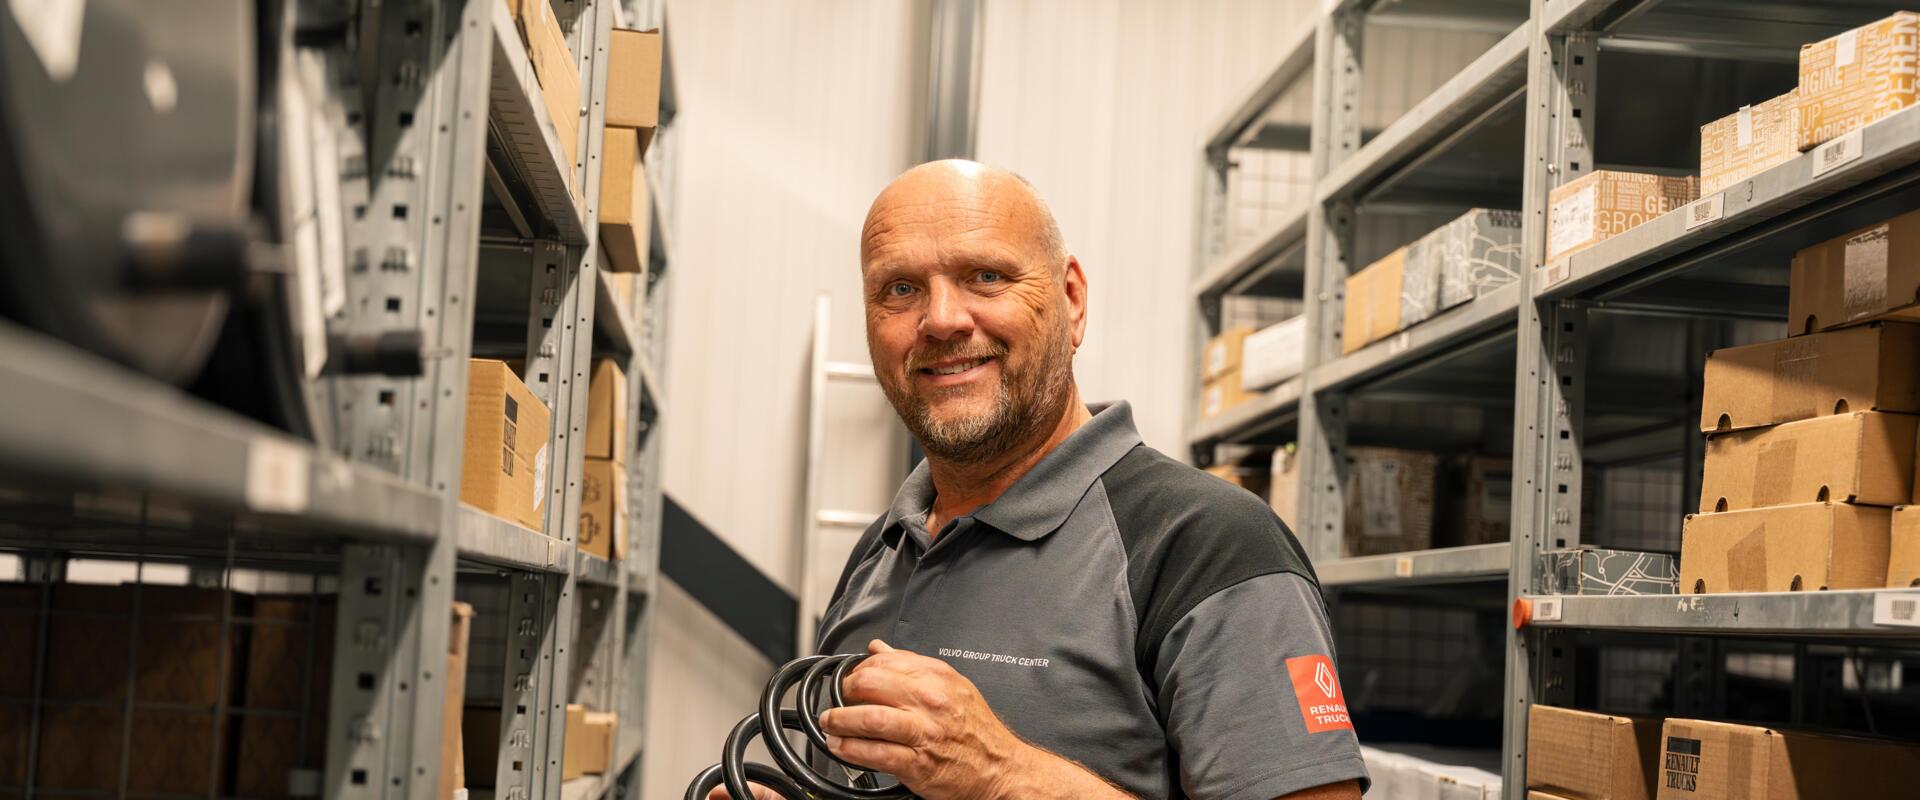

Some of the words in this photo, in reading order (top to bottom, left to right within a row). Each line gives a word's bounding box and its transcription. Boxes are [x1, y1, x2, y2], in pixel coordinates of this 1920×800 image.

[1746, 180, 1754, 202] 3
[939, 647, 962, 658] VOLVO
[962, 650, 991, 661] GROUP
[991, 654, 1018, 665] TRUCK
[1018, 657, 1050, 668] CENTER
[1665, 752, 1701, 774] RENAULT
[1666, 770, 1697, 792] TRUCKS
